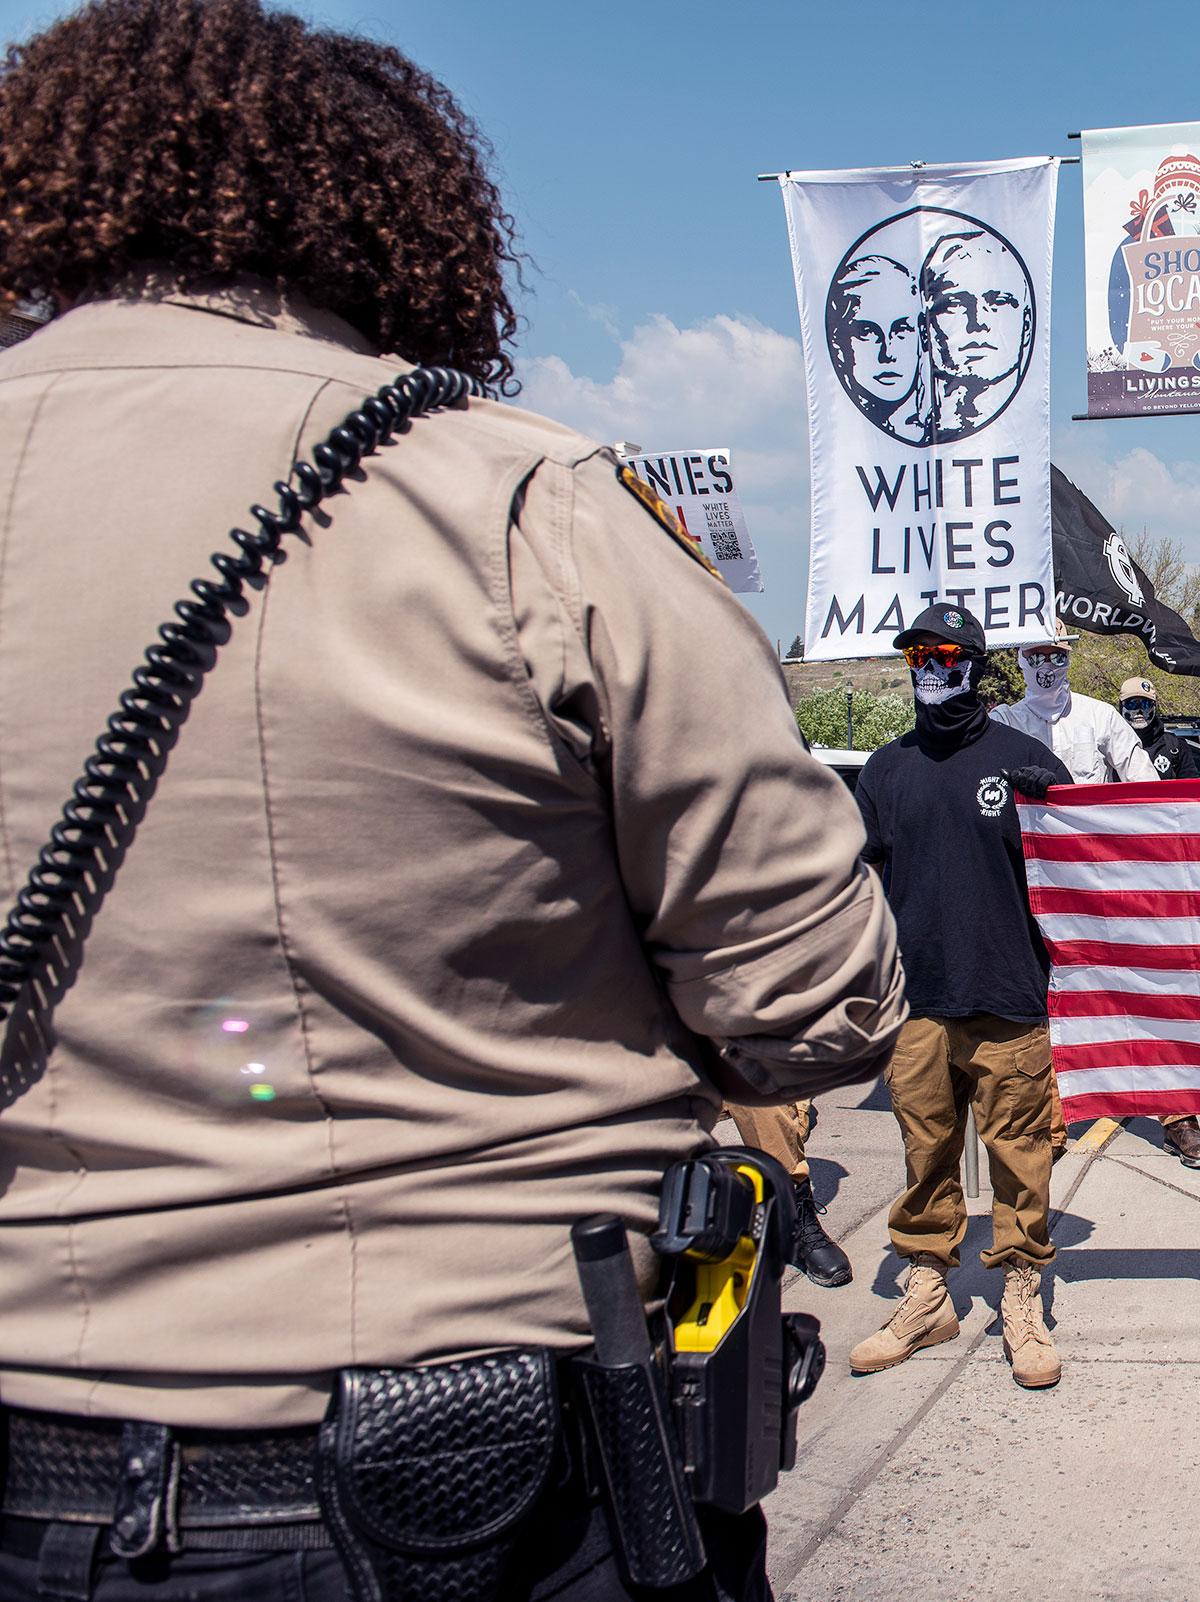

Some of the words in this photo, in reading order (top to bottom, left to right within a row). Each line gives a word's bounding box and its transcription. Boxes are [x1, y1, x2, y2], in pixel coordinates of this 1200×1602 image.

[1176, 322, 1195, 330] YOUR
[855, 455, 1021, 513] WHITE
[702, 502, 729, 511] WHITE
[705, 511, 730, 521] LIVES
[707, 520, 734, 528] MATTER
[871, 519, 1015, 575] LIVES
